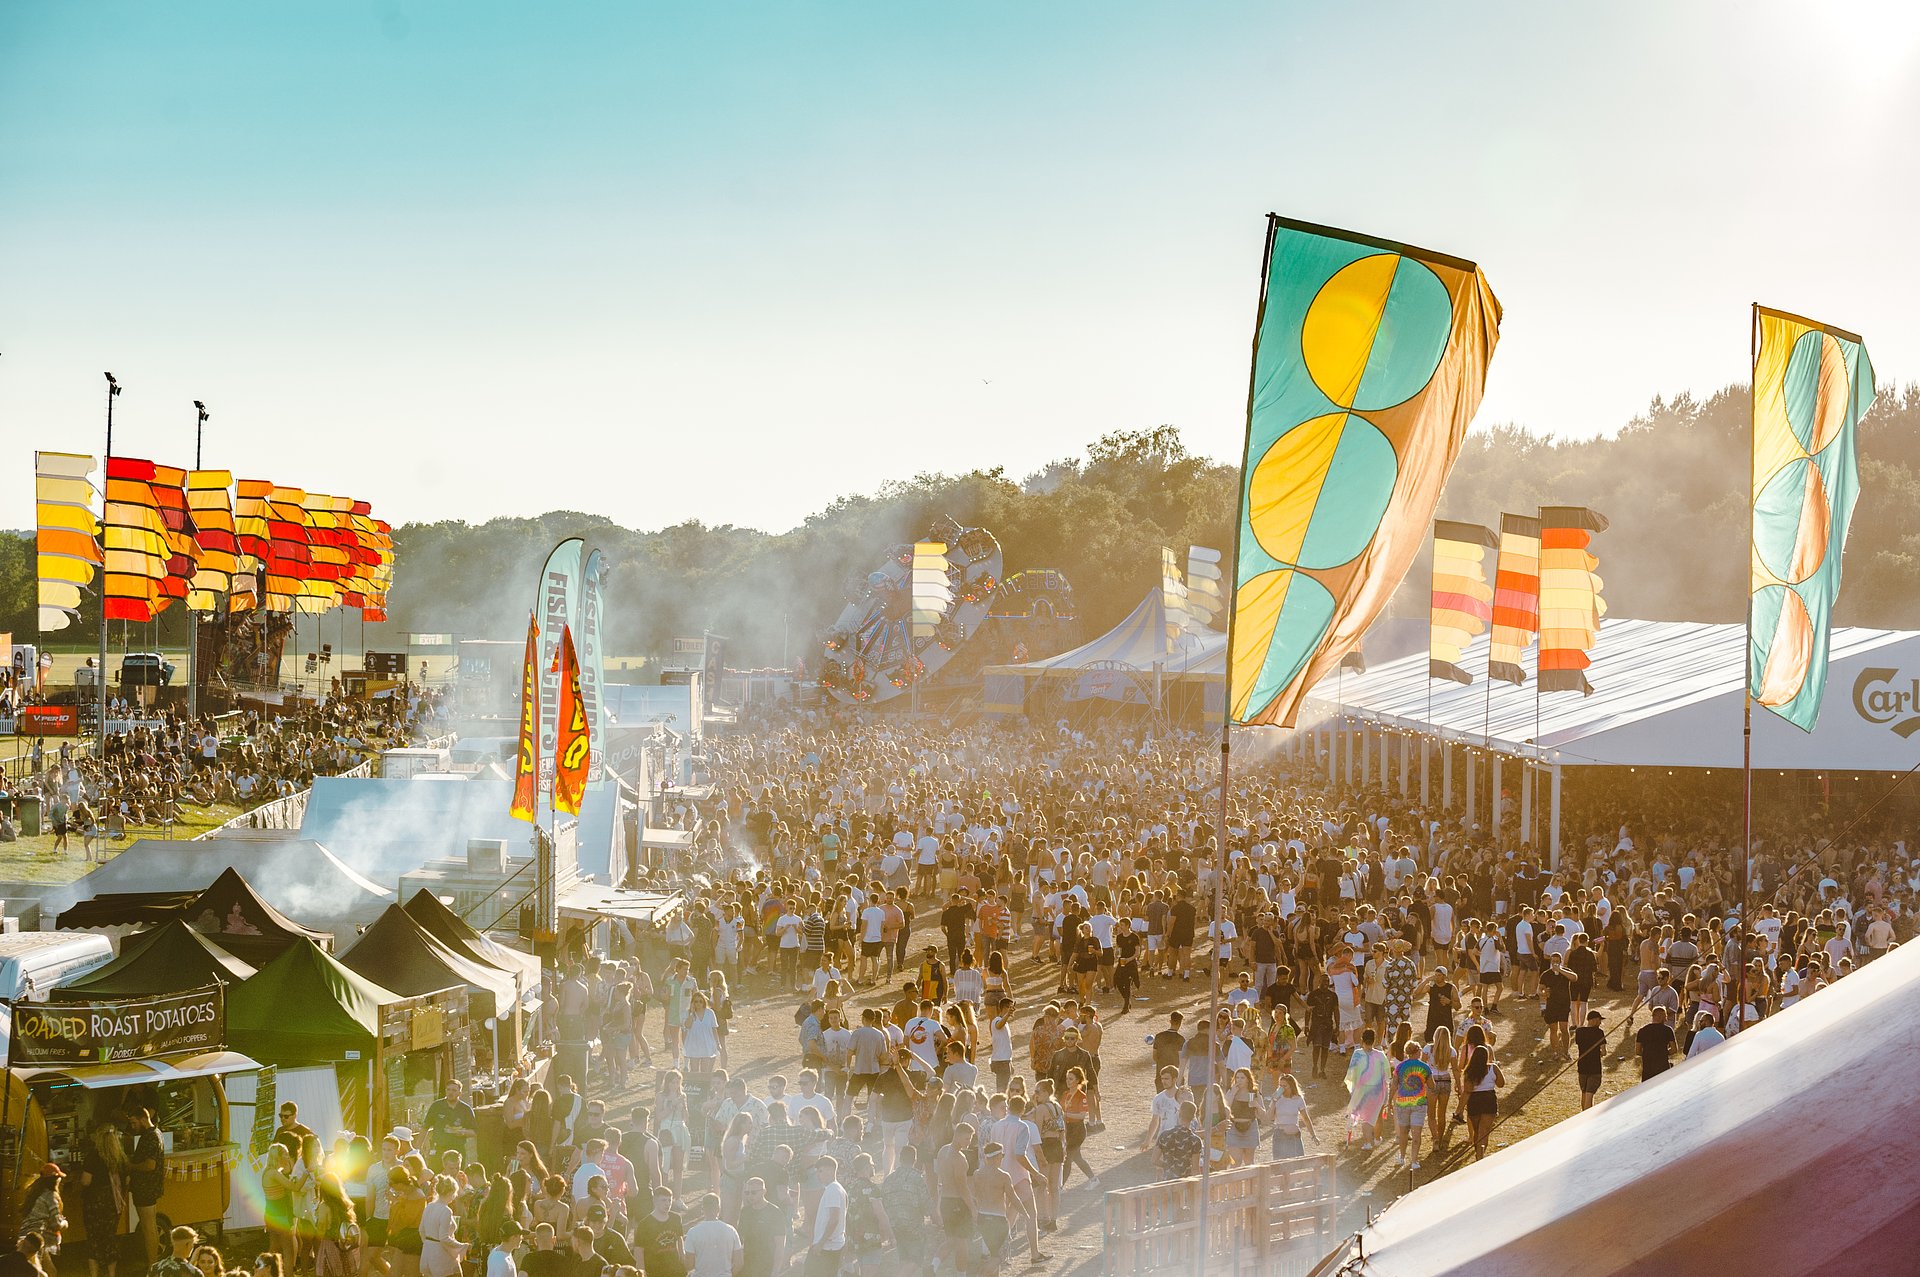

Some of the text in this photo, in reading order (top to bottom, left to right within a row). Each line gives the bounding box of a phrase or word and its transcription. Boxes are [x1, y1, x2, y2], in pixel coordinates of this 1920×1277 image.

[547, 572, 568, 633] FISH
[584, 578, 597, 636] FISH
[15, 1002, 215, 1040] LOADED ROAST POTATOES
[183, 1033, 208, 1044] POPPERS
[49, 1048, 66, 1056] FRIES
